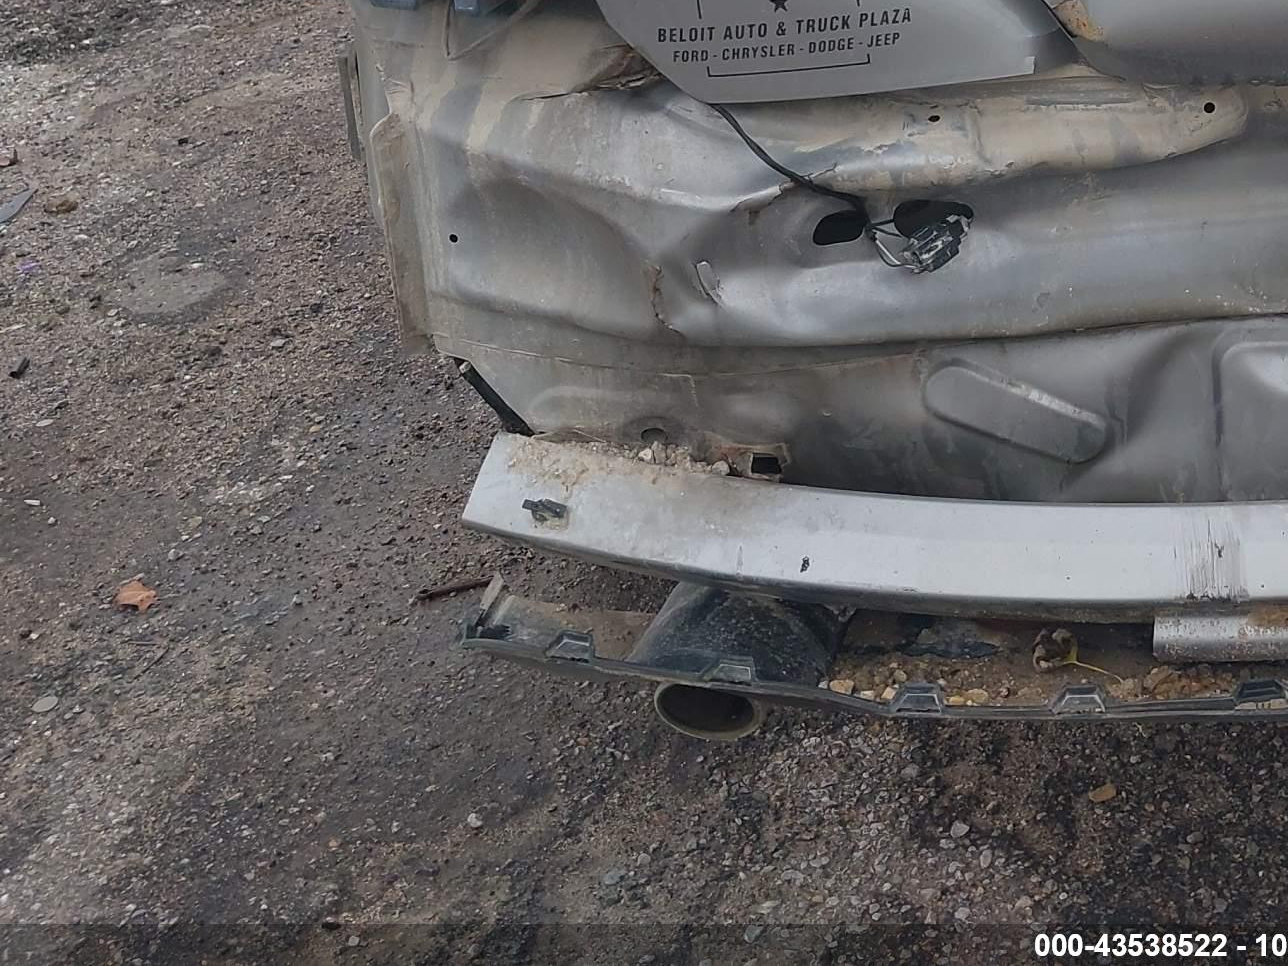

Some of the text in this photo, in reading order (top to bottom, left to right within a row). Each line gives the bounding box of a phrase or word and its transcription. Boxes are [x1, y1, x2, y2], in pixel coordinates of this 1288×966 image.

[657, 7, 912, 43] BELOIT AUTO & TRUCK PLAZA
[673, 49, 709, 63] FORD
[721, 43, 796, 62] CHRYSLER
[808, 37, 855, 55] DODGE
[867, 32, 901, 49] JEEP
